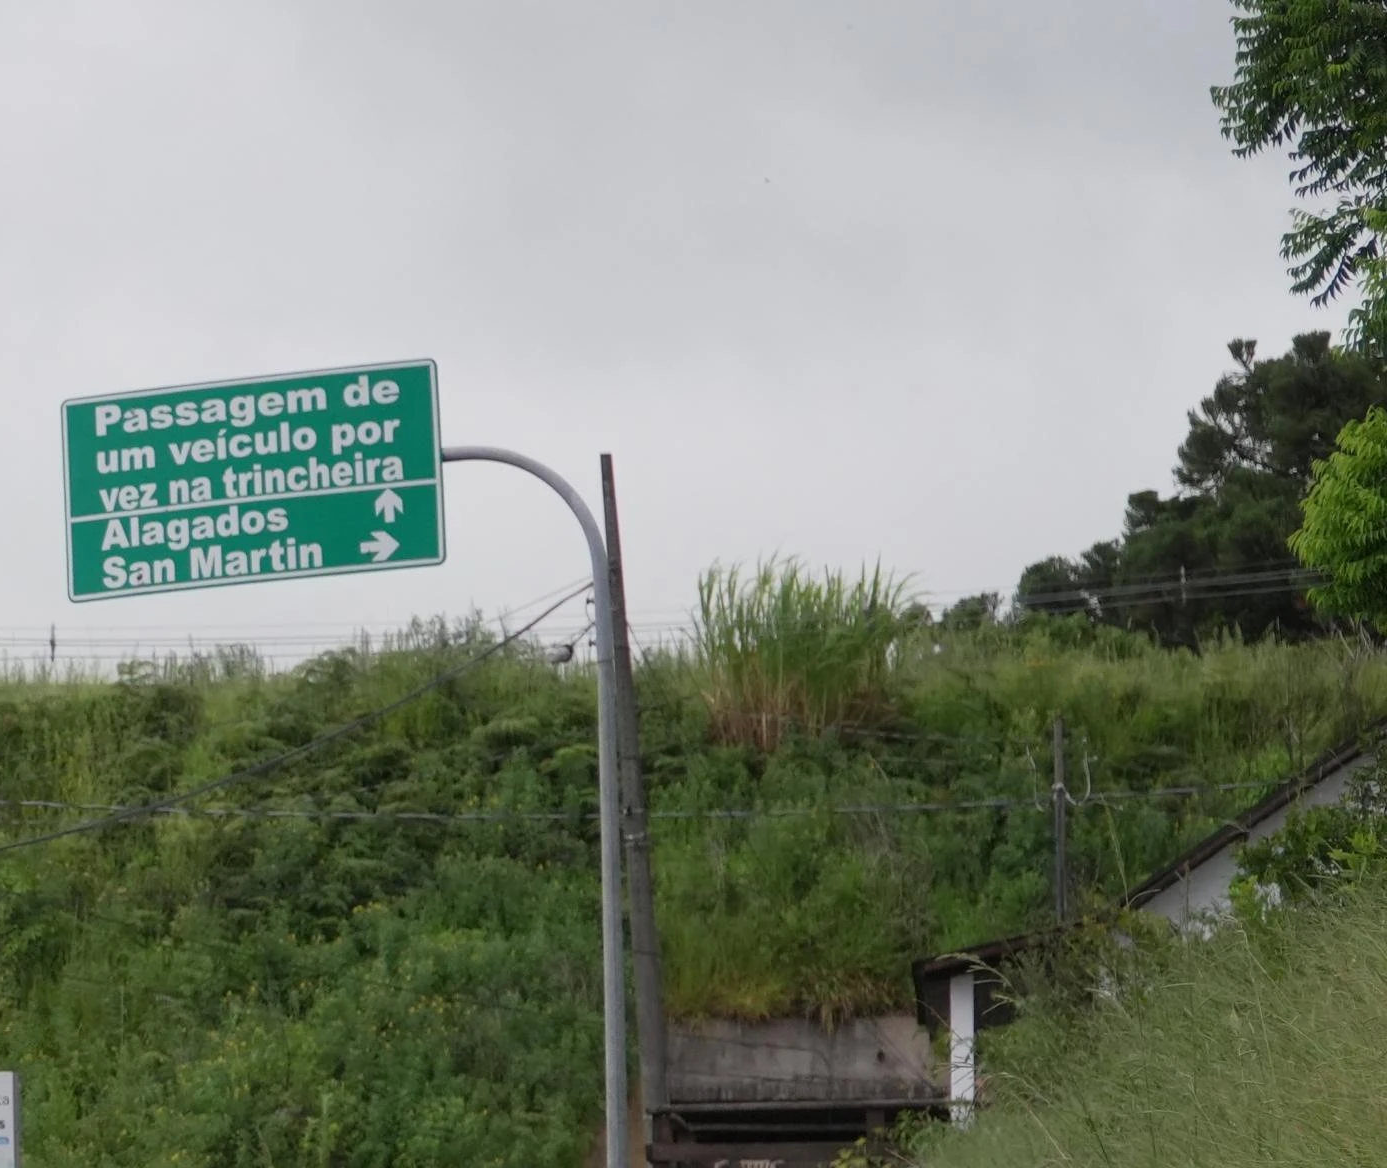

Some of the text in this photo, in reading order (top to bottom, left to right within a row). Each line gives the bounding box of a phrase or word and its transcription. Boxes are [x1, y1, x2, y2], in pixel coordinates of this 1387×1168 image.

[95, 375, 400, 436] Passagem de
[96, 418, 400, 474] um veículo por
[99, 453, 404, 512] vez na trincheira
[101, 506, 289, 551] Alagados
[102, 538, 323, 589] San Martin
